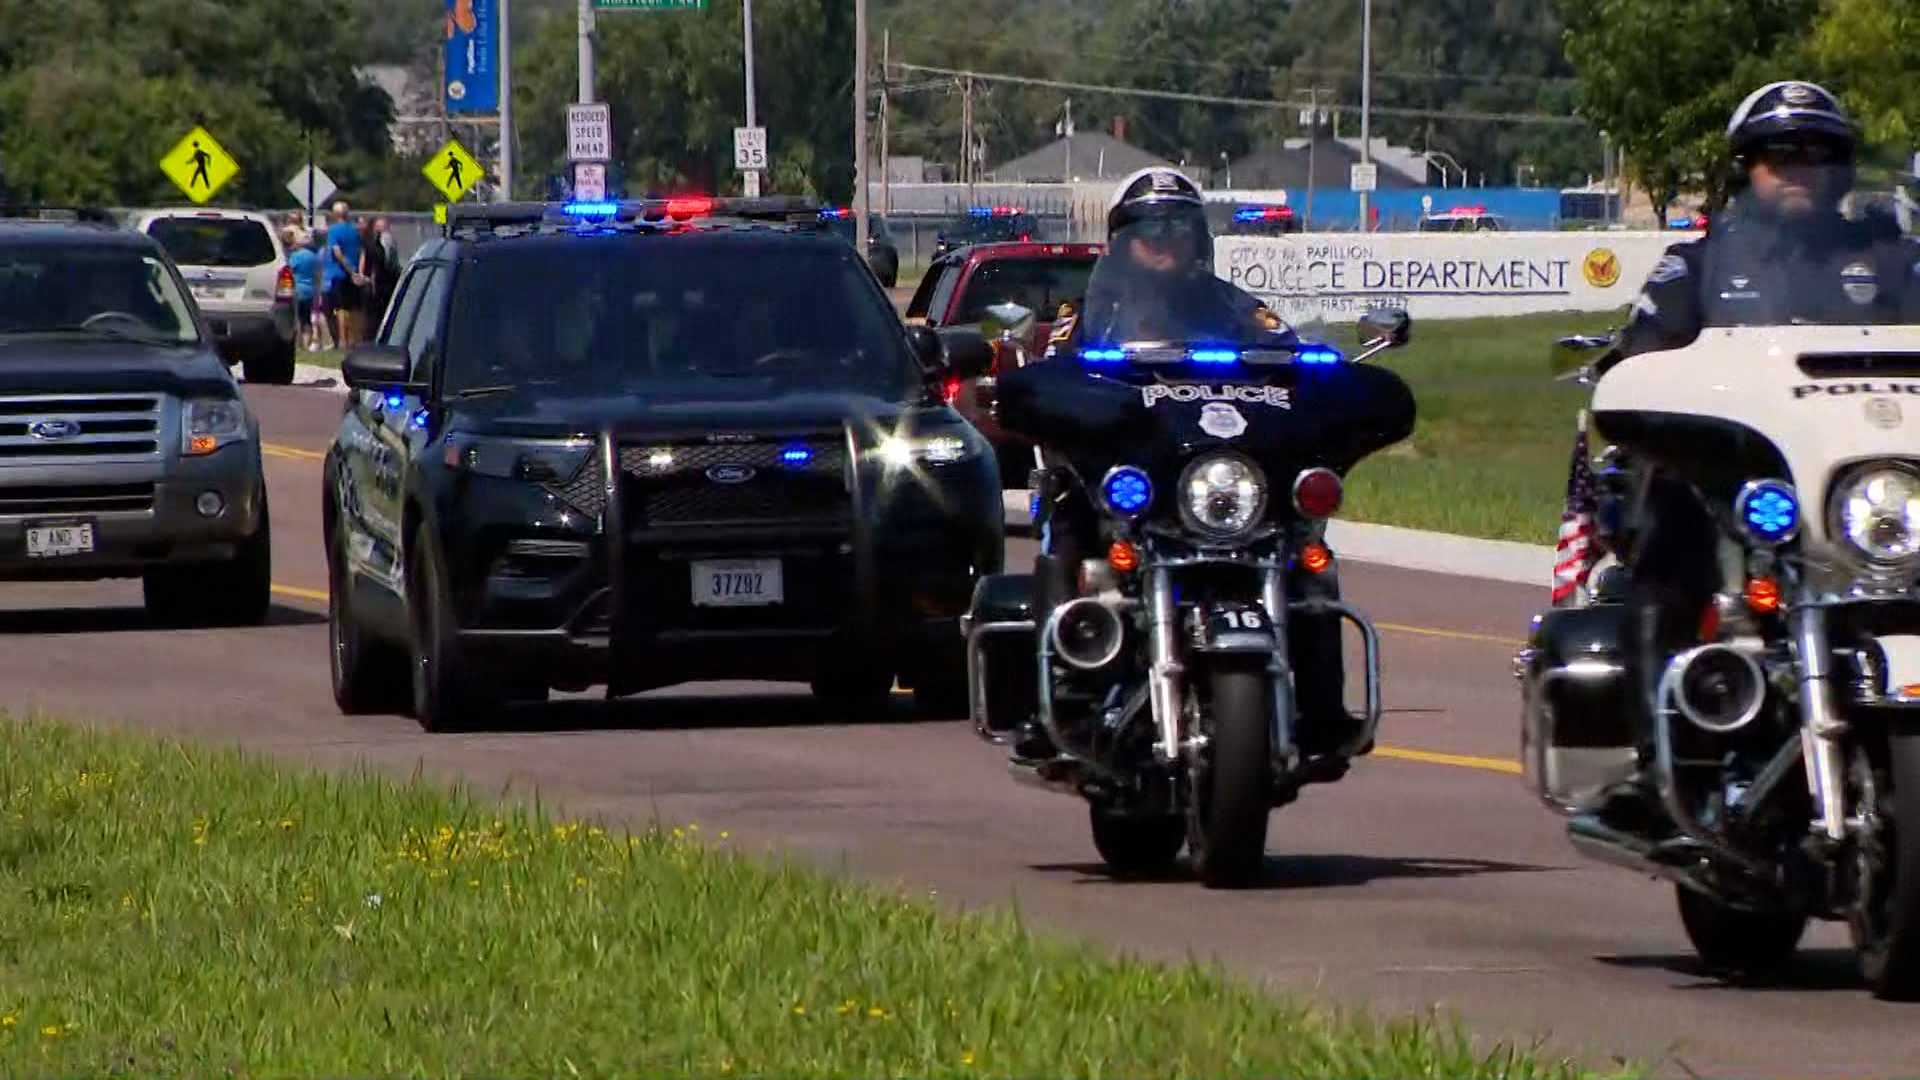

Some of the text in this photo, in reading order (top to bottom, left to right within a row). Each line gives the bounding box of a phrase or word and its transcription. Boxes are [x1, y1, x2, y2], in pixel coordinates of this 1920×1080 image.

[575, 127, 602, 138] SPEED
[576, 143, 604, 153] AHEAD
[739, 149, 763, 163] 35
[1306, 245, 1373, 260] PAPILLION
[1363, 260, 1569, 289] DEPARTMENT
[1321, 299, 1354, 312] FIRST
[1141, 384, 1292, 410] POLICE
[49, 528, 72, 546] AND
[1223, 610, 1262, 629] 16
